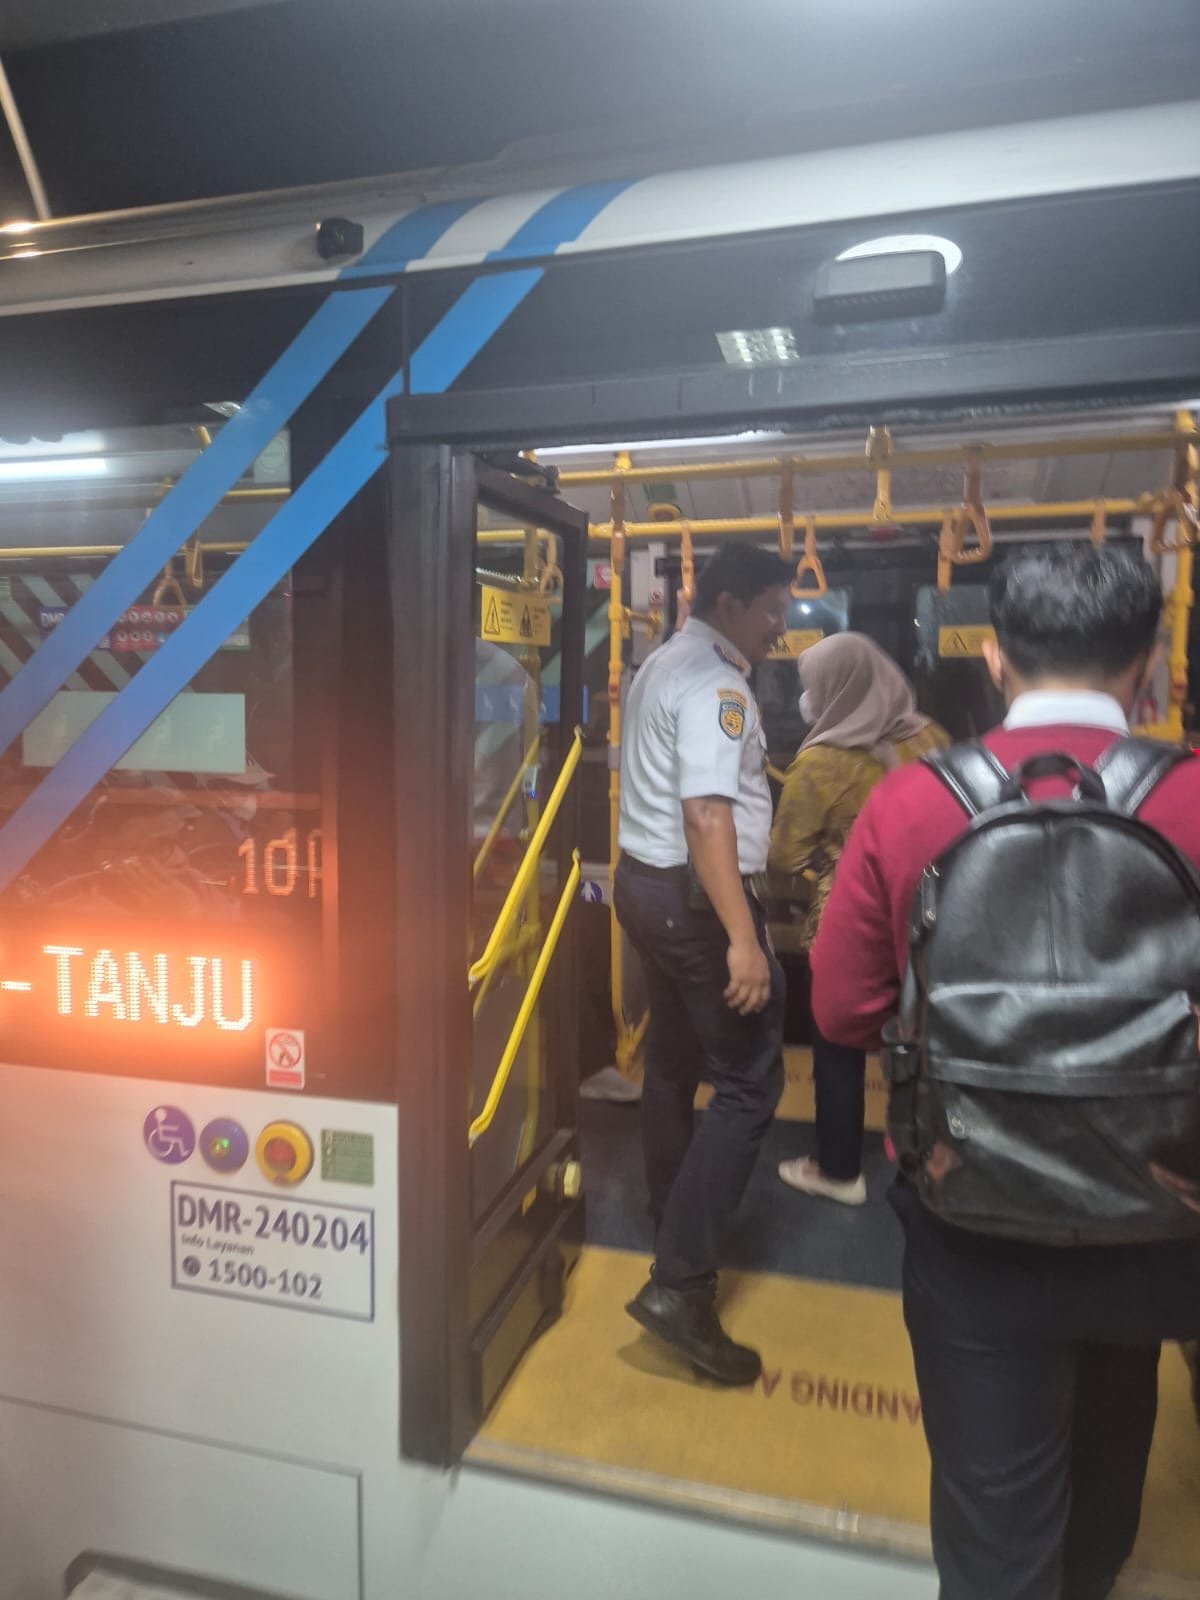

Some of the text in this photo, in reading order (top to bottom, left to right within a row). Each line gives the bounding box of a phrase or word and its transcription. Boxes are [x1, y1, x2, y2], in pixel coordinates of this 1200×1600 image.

[43, 944, 254, 1031] TANJU
[177, 1194, 369, 1255] DMR-240204
[180, 1233, 255, 1256] Info Layanan
[208, 1258, 323, 1299] 1500-102
